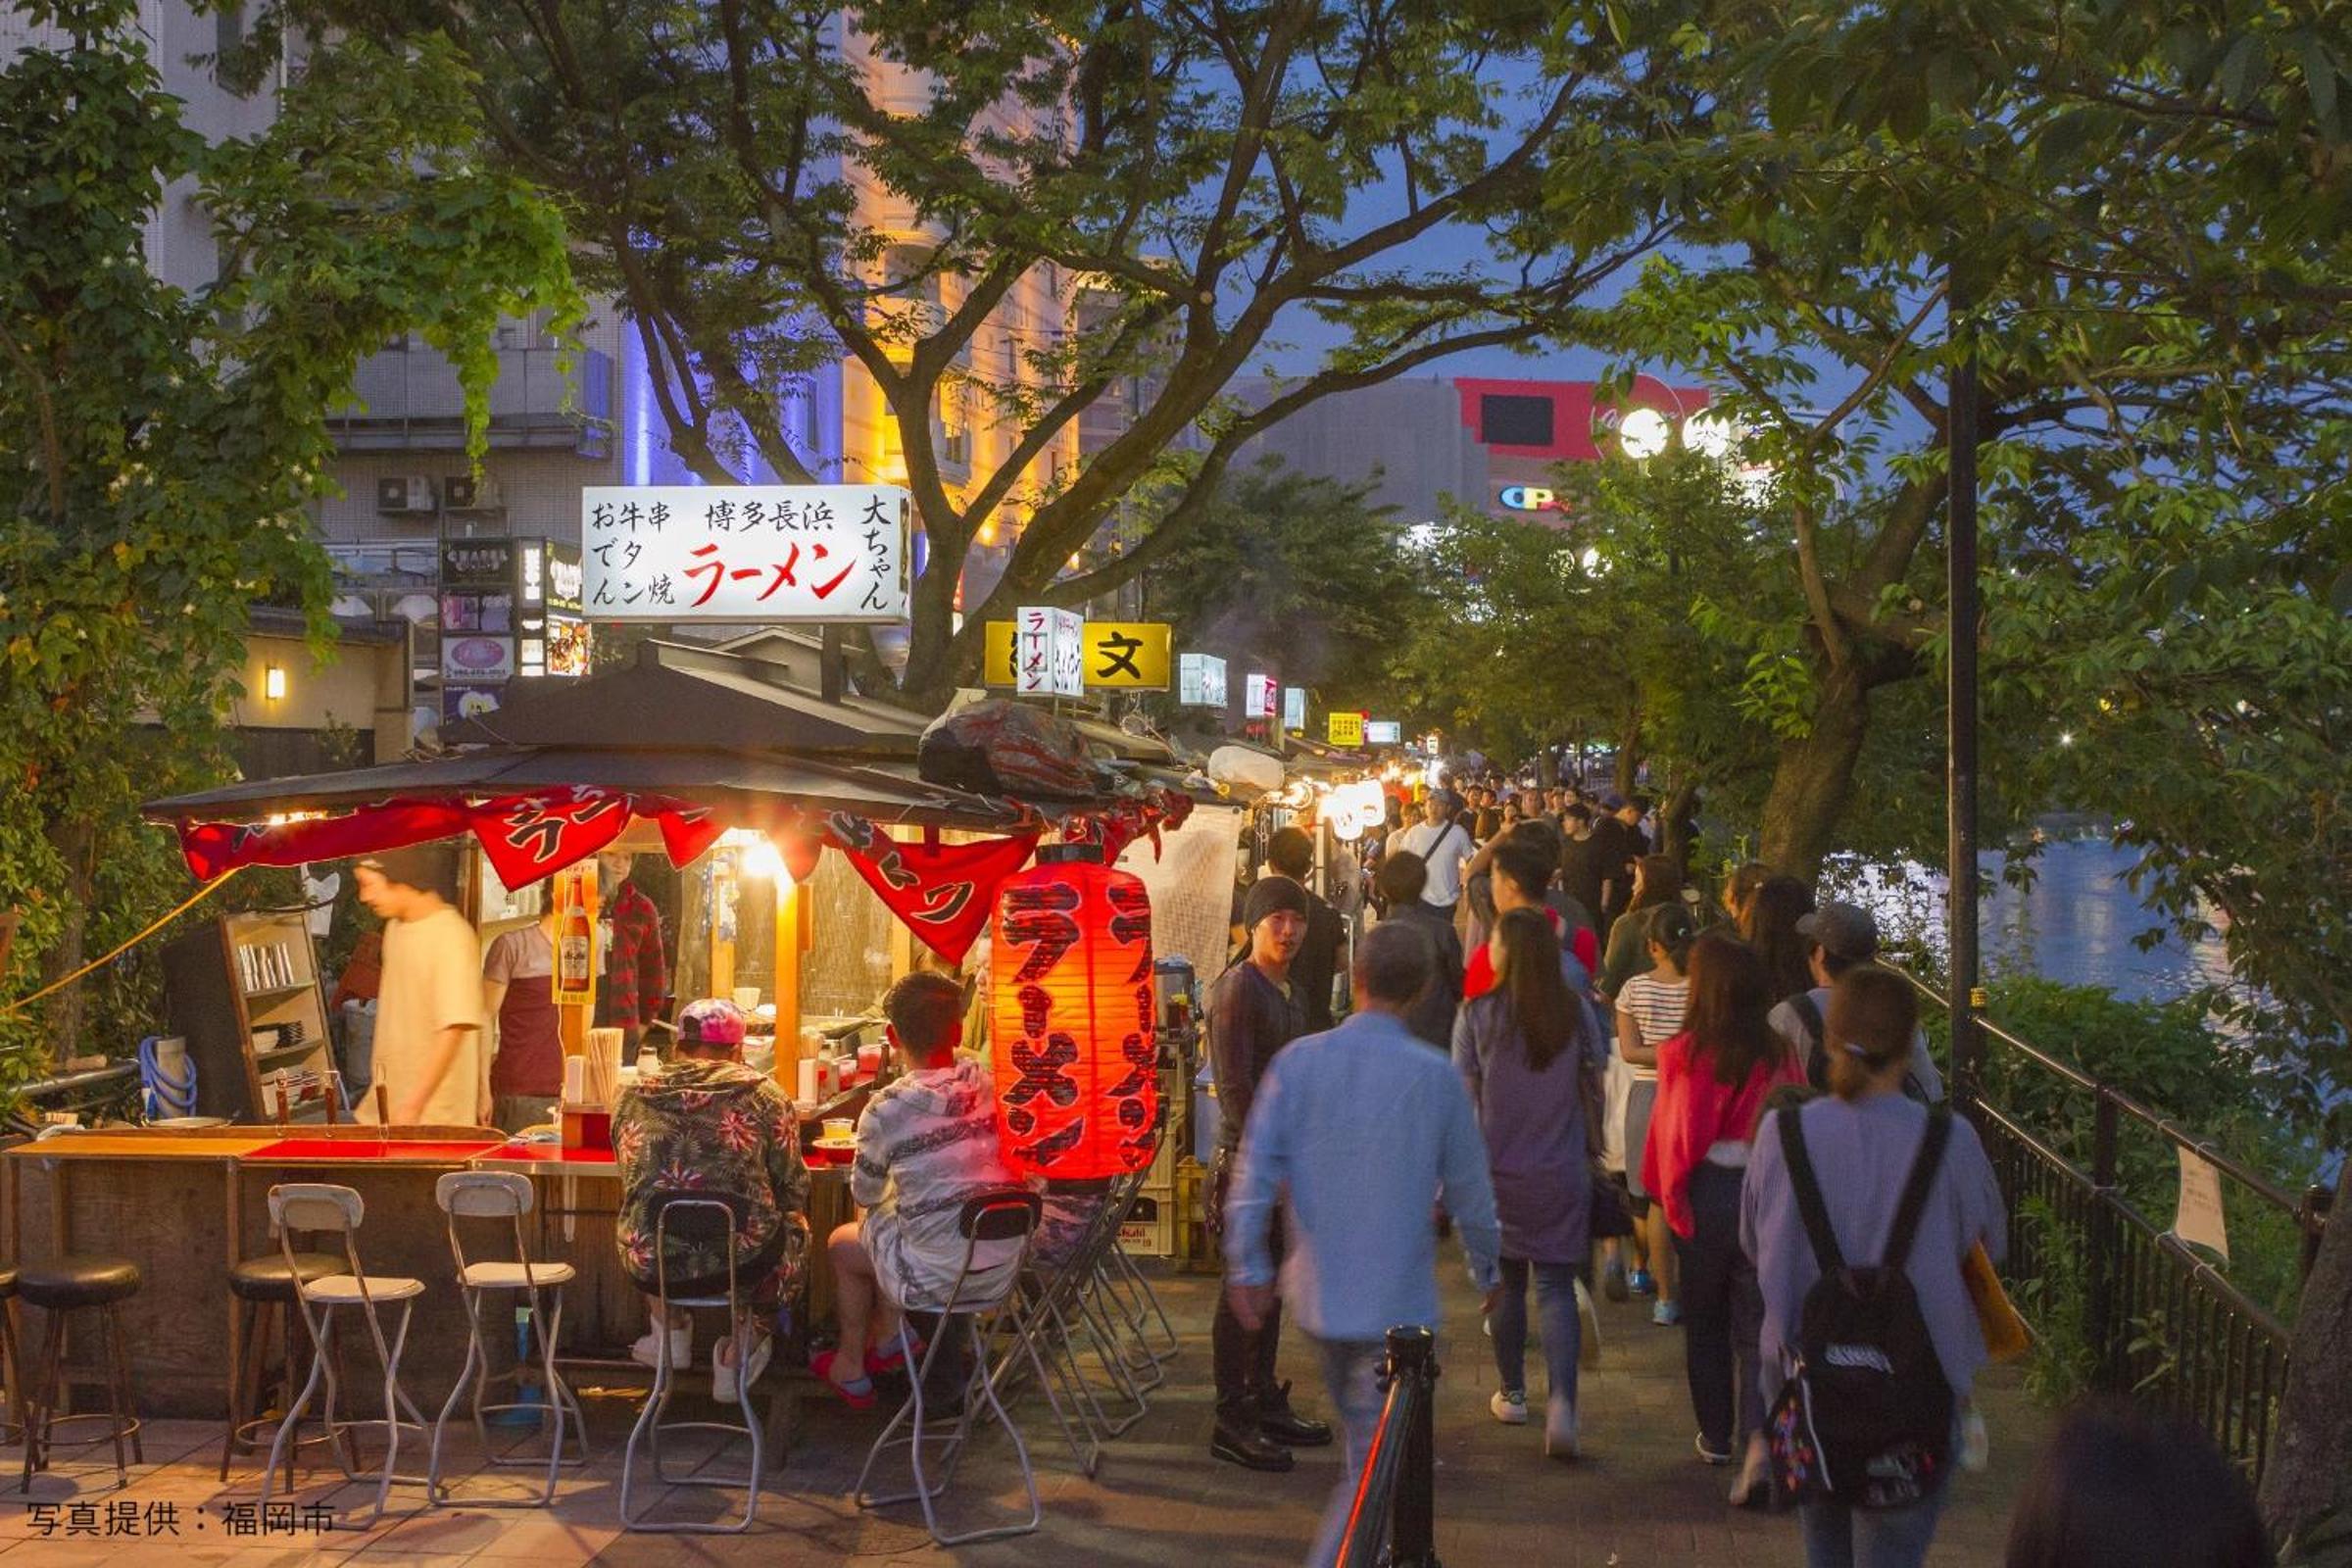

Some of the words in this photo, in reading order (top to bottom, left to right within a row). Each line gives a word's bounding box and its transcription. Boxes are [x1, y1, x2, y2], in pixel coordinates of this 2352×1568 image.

[591, 502, 616, 605] おでん
[705, 499, 834, 533] 博多長浜
[859, 493, 892, 611] 大ちゃん
[683, 541, 858, 608] ラーメン
[1025, 612, 1045, 690] ラーメン
[1002, 882, 1085, 1166] ラーメン
